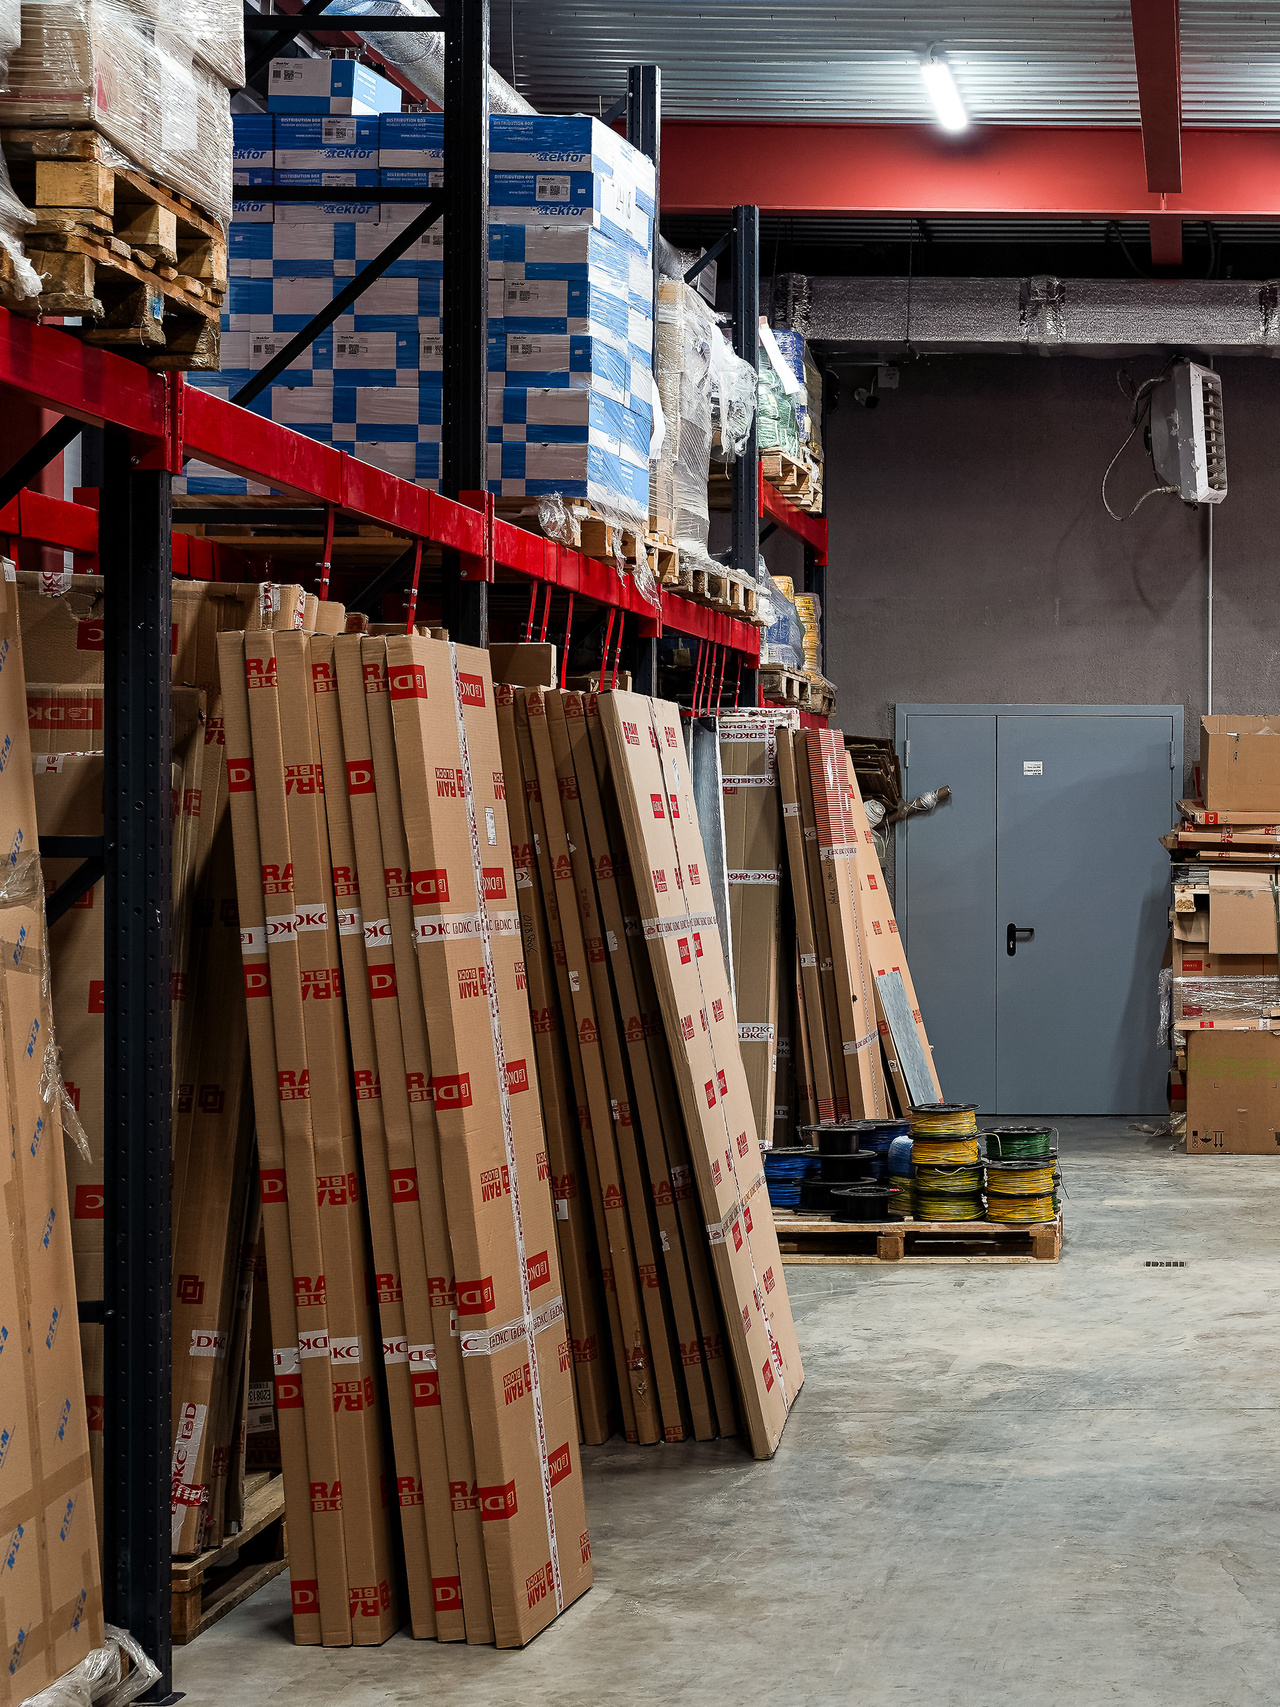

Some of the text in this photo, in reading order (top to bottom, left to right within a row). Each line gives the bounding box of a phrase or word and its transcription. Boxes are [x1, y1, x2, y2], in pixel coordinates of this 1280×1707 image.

[233, 149, 266, 159] ekfor
[333, 148, 373, 159] tekfor
[544, 152, 586, 162] tekfor
[233, 202, 266, 212] ekfor
[333, 202, 372, 213] tekfor
[544, 205, 586, 216] tekfor
[246, 657, 276, 675] RA
[28, 707, 64, 720] DK
[436, 780, 456, 797] RAM
[262, 863, 293, 881] RA
[459, 981, 479, 999] RAM
[278, 1069, 309, 1087] RA
[482, 1181, 502, 1202] RAM
[294, 1275, 325, 1293] RA
[248, 1389, 271, 1400] E20813
[504, 1380, 523, 1405] RAM
[310, 1481, 341, 1498] RA
[527, 1579, 547, 1609] RAM
